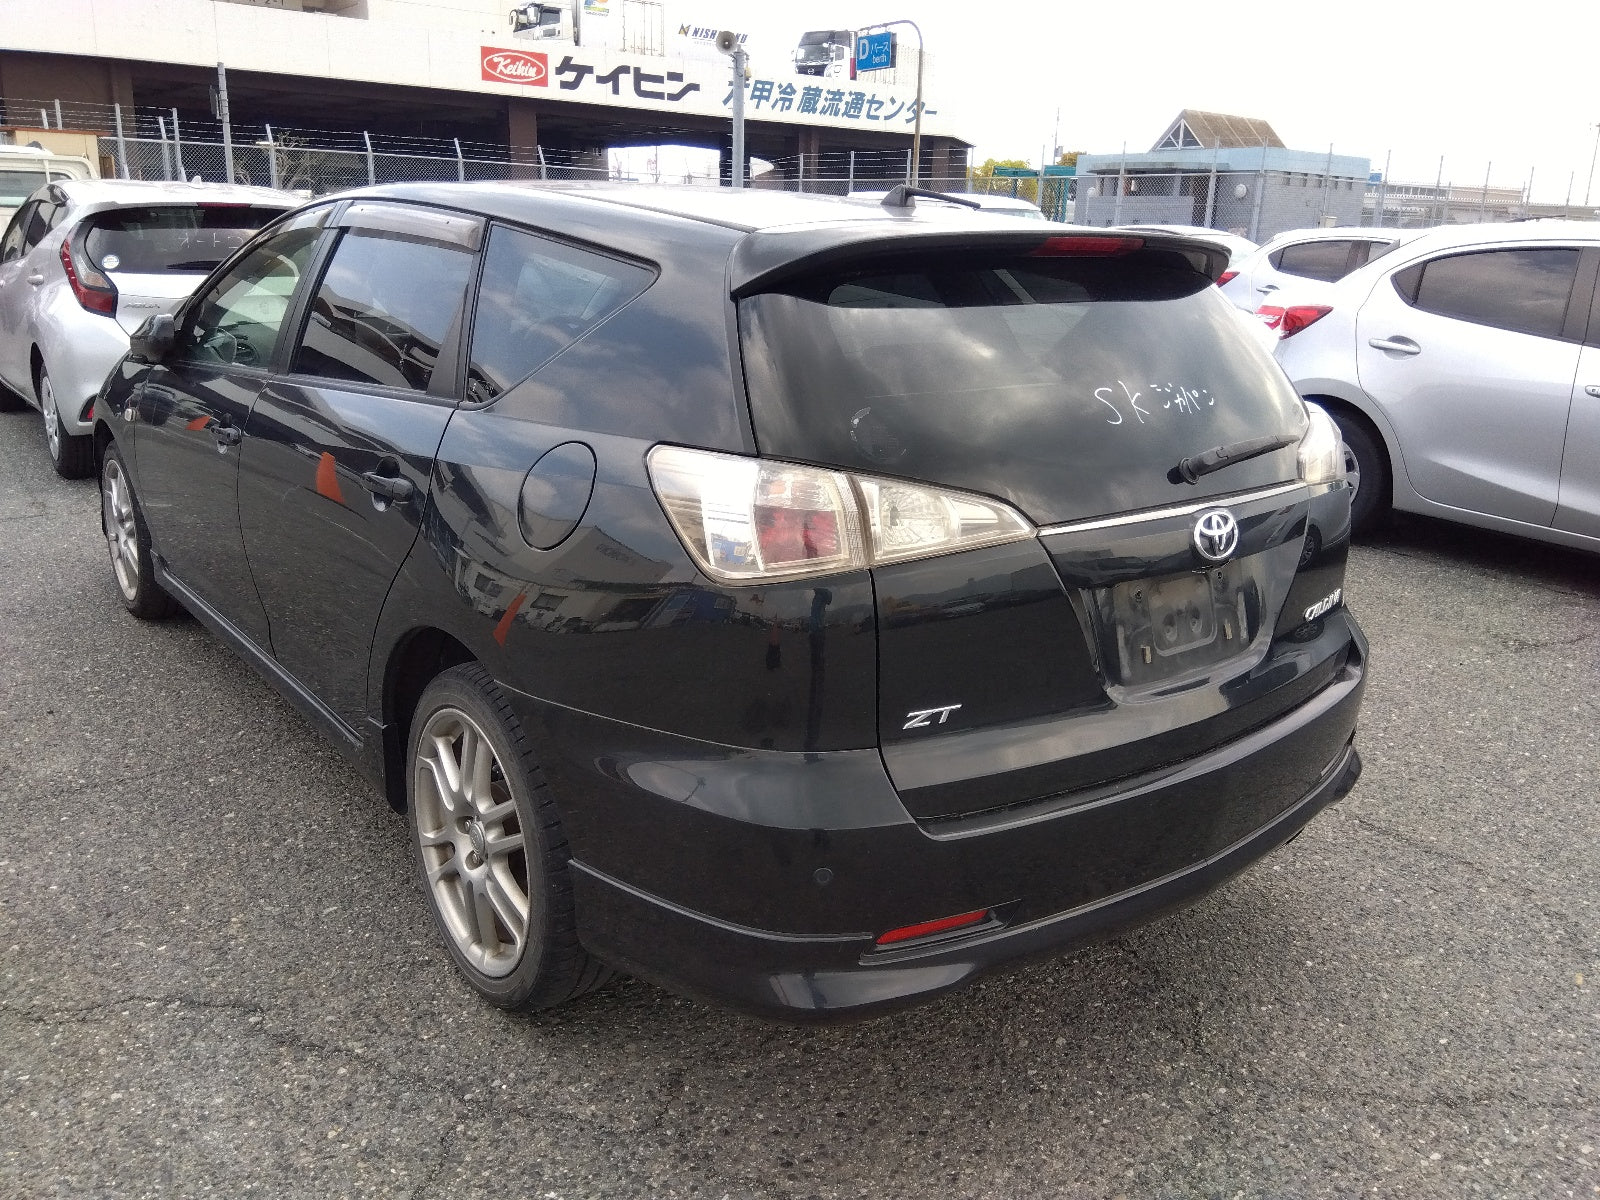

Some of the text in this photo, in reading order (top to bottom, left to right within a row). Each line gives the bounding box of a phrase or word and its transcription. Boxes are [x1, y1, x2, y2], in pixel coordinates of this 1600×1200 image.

[859, 38, 870, 60] D
[492, 56, 538, 78] Keihin
[555, 55, 700, 101] ケイヒン
[902, 703, 963, 730] ZT
